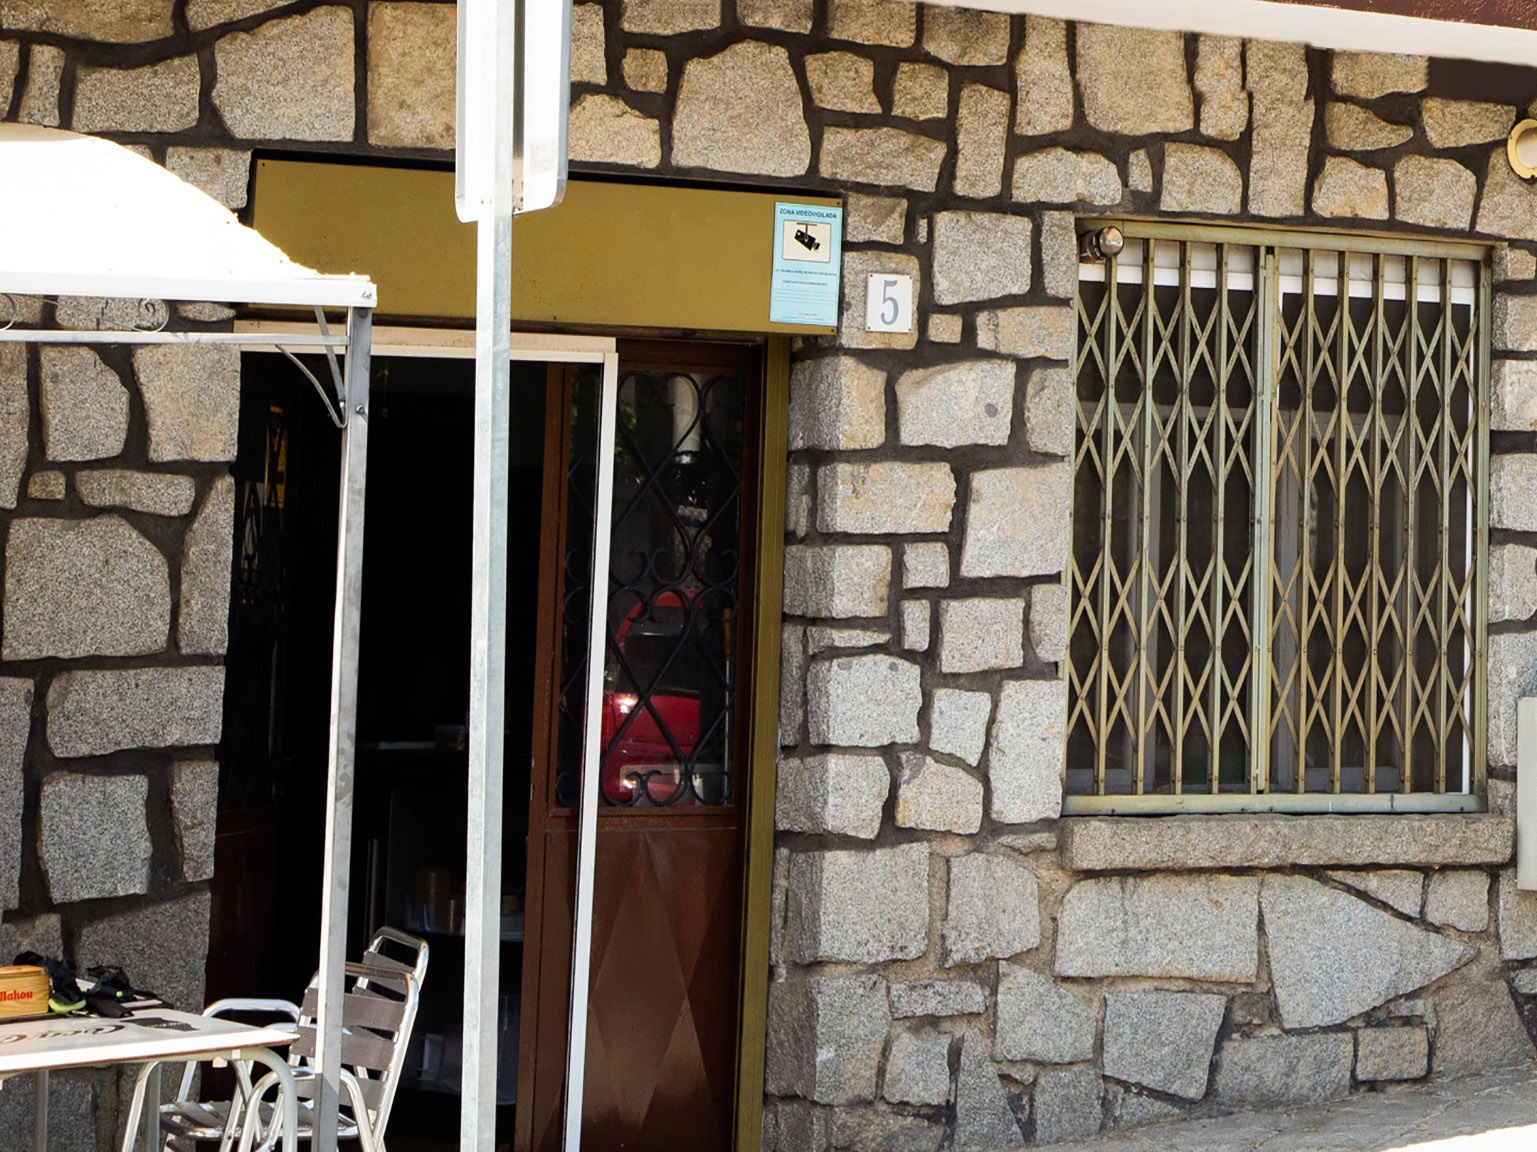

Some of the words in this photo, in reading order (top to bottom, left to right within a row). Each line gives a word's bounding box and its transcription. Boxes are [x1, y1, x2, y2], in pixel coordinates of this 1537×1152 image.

[779, 208, 795, 216] ZONA
[795, 209, 837, 219] VIDEOVIGILADA
[880, 279, 899, 326] 5
